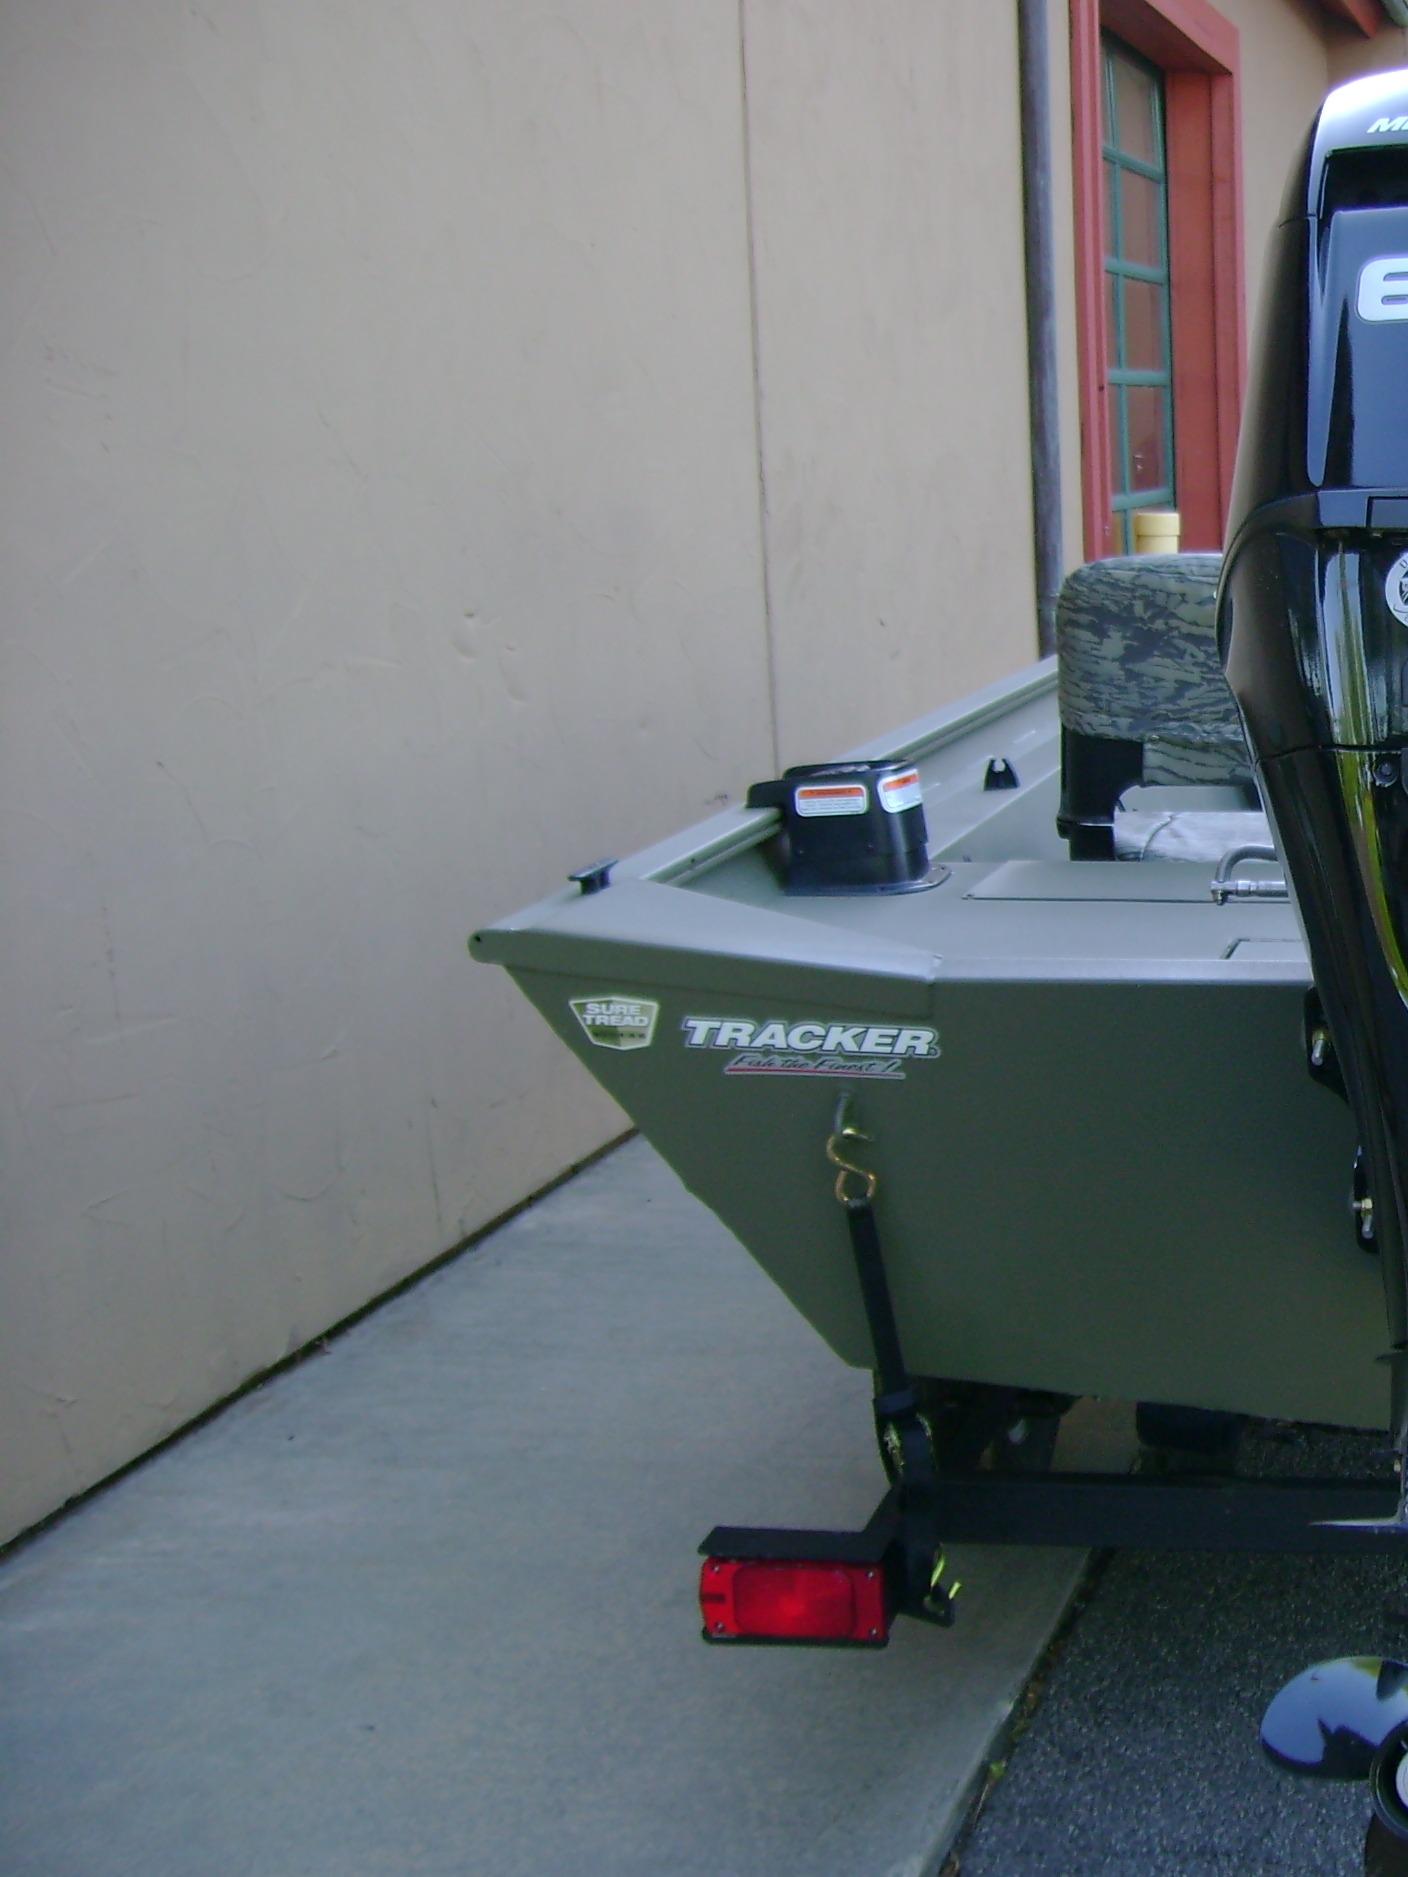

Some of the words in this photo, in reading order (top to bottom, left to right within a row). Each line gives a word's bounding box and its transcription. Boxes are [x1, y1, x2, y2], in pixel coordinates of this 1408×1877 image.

[586, 1002, 641, 1015] SURE
[582, 1014, 649, 1026] TREAD
[685, 1019, 936, 1055] TRACKER
[733, 1055, 776, 1067] Fish
[779, 1056, 810, 1068] the
